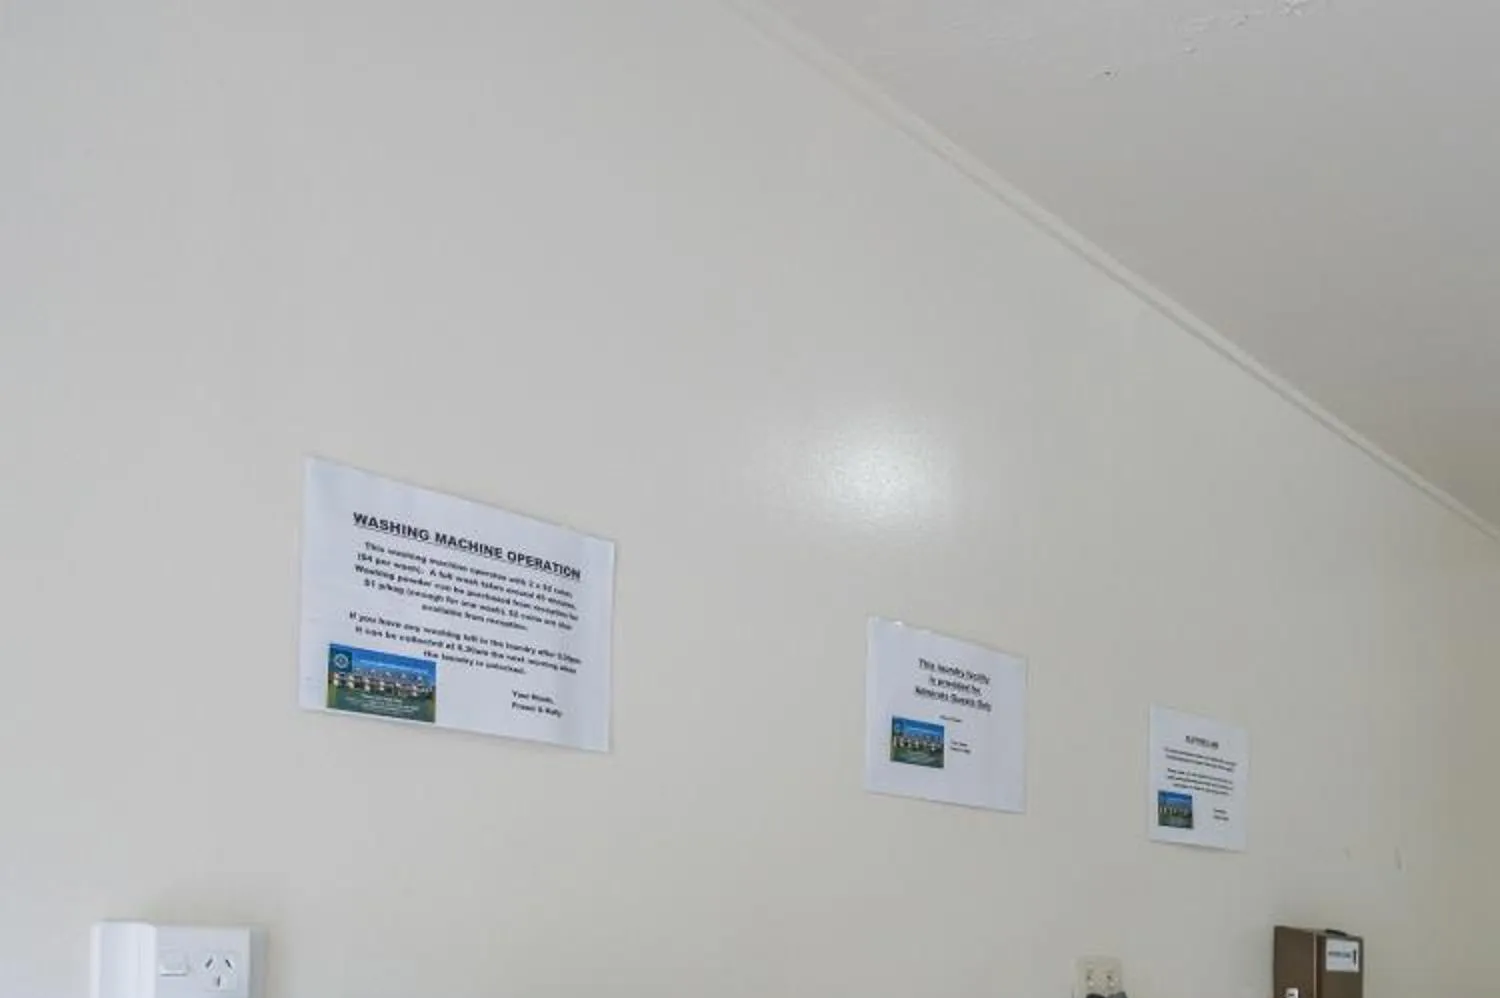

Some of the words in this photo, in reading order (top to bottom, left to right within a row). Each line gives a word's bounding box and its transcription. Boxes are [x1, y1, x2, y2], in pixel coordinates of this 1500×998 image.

[352, 511, 430, 541] WASHING
[435, 531, 503, 560] MACHINE
[507, 550, 581, 580] OPERATION
[387, 549, 427, 565] washing
